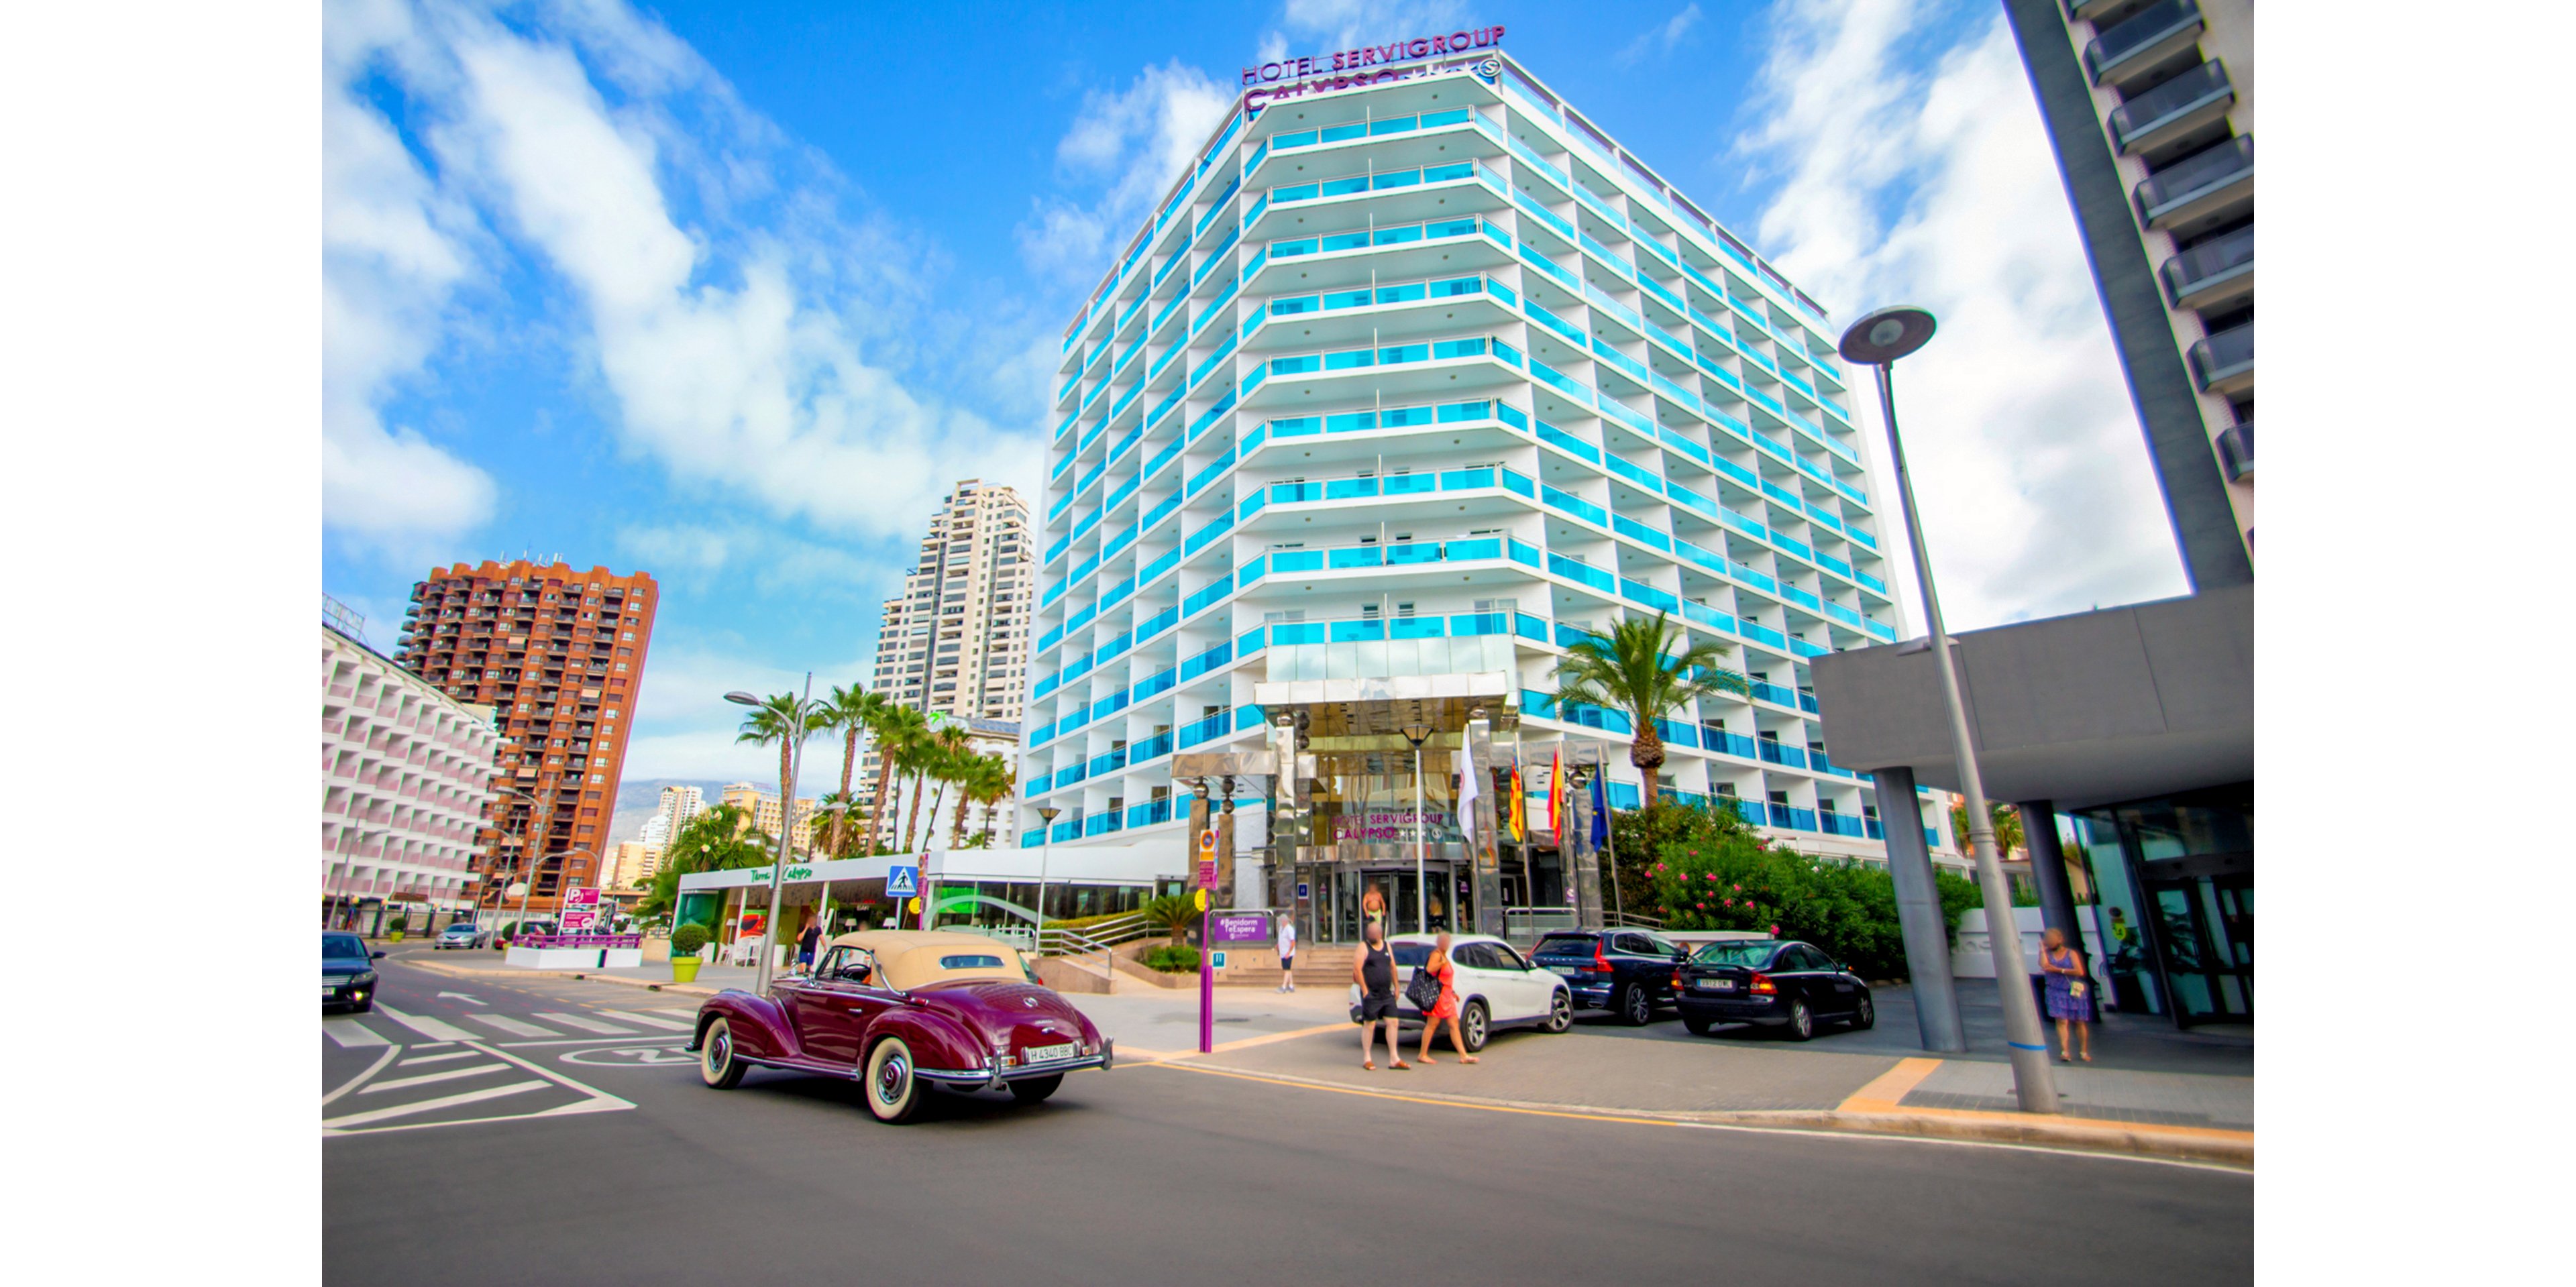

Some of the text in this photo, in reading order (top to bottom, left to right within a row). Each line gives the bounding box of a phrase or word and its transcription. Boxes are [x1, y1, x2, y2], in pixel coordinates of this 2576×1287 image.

[1242, 25, 1505, 85] HOTEL SERVIGROUP
[1332, 813, 1444, 826] HOTEL SERVIGROUP
[1334, 826, 1395, 840] CALYPSO
[1220, 917, 1258, 926] #Benidorm
[1225, 924, 1256, 934] TeEspera
[1031, 1050, 1037, 1060] H
[1039, 1048, 1058, 1059] 4340
